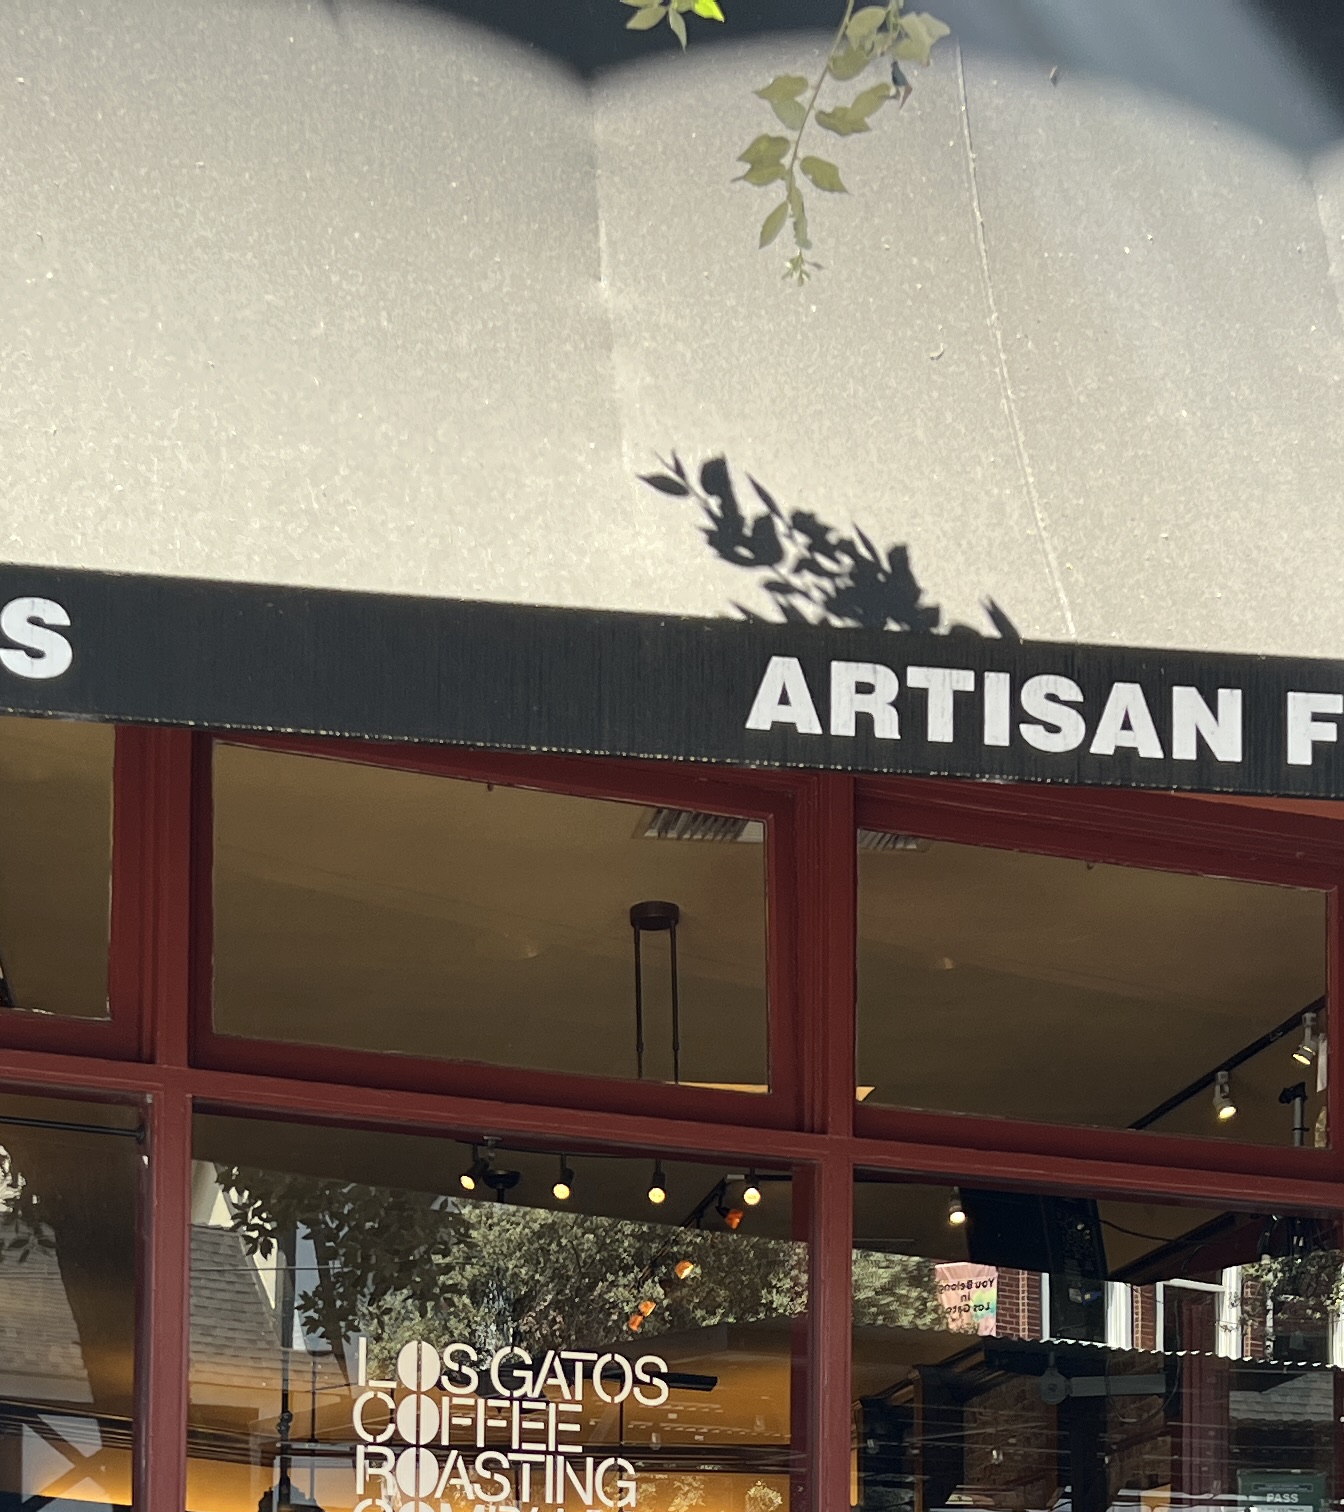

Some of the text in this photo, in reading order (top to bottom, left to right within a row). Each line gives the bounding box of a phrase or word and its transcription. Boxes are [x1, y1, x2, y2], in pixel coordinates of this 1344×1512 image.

[745, 655, 1244, 764] ARTISAN
[358, 1336, 669, 1406] LOS GATOS
[352, 1391, 583, 1453] COFFEE
[356, 1444, 637, 1508] ROASTING
[1266, 1493, 1299, 1503] PASS
